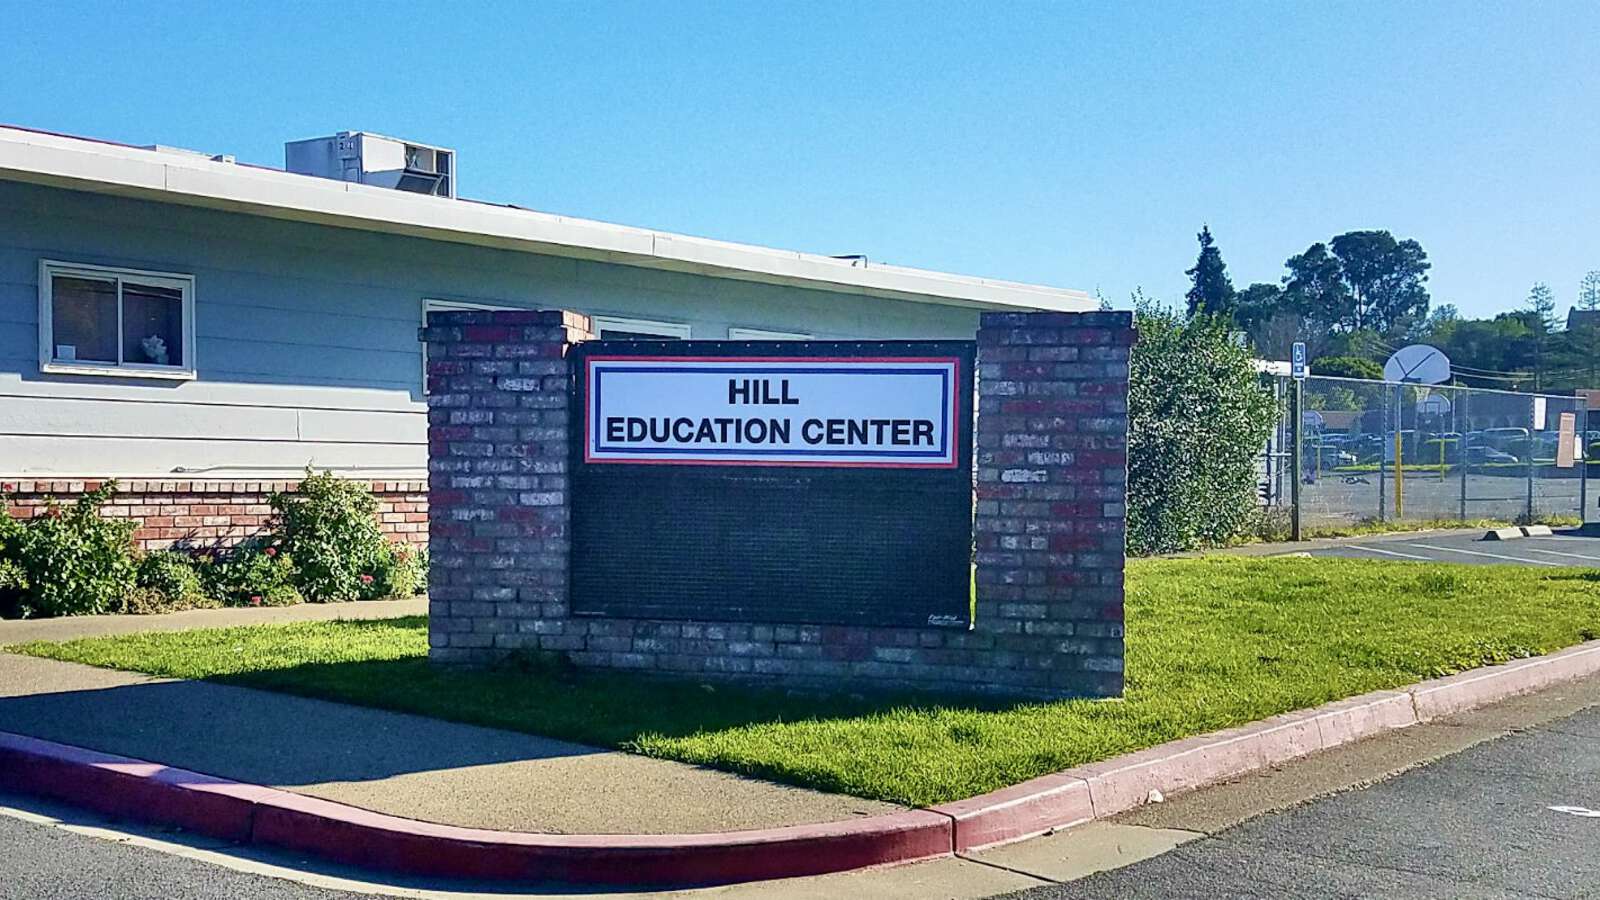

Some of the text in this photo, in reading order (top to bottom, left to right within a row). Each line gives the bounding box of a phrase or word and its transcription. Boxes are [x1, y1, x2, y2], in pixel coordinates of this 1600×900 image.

[728, 379, 800, 405] HILL
[606, 416, 935, 446] EDUCATION CENTER
